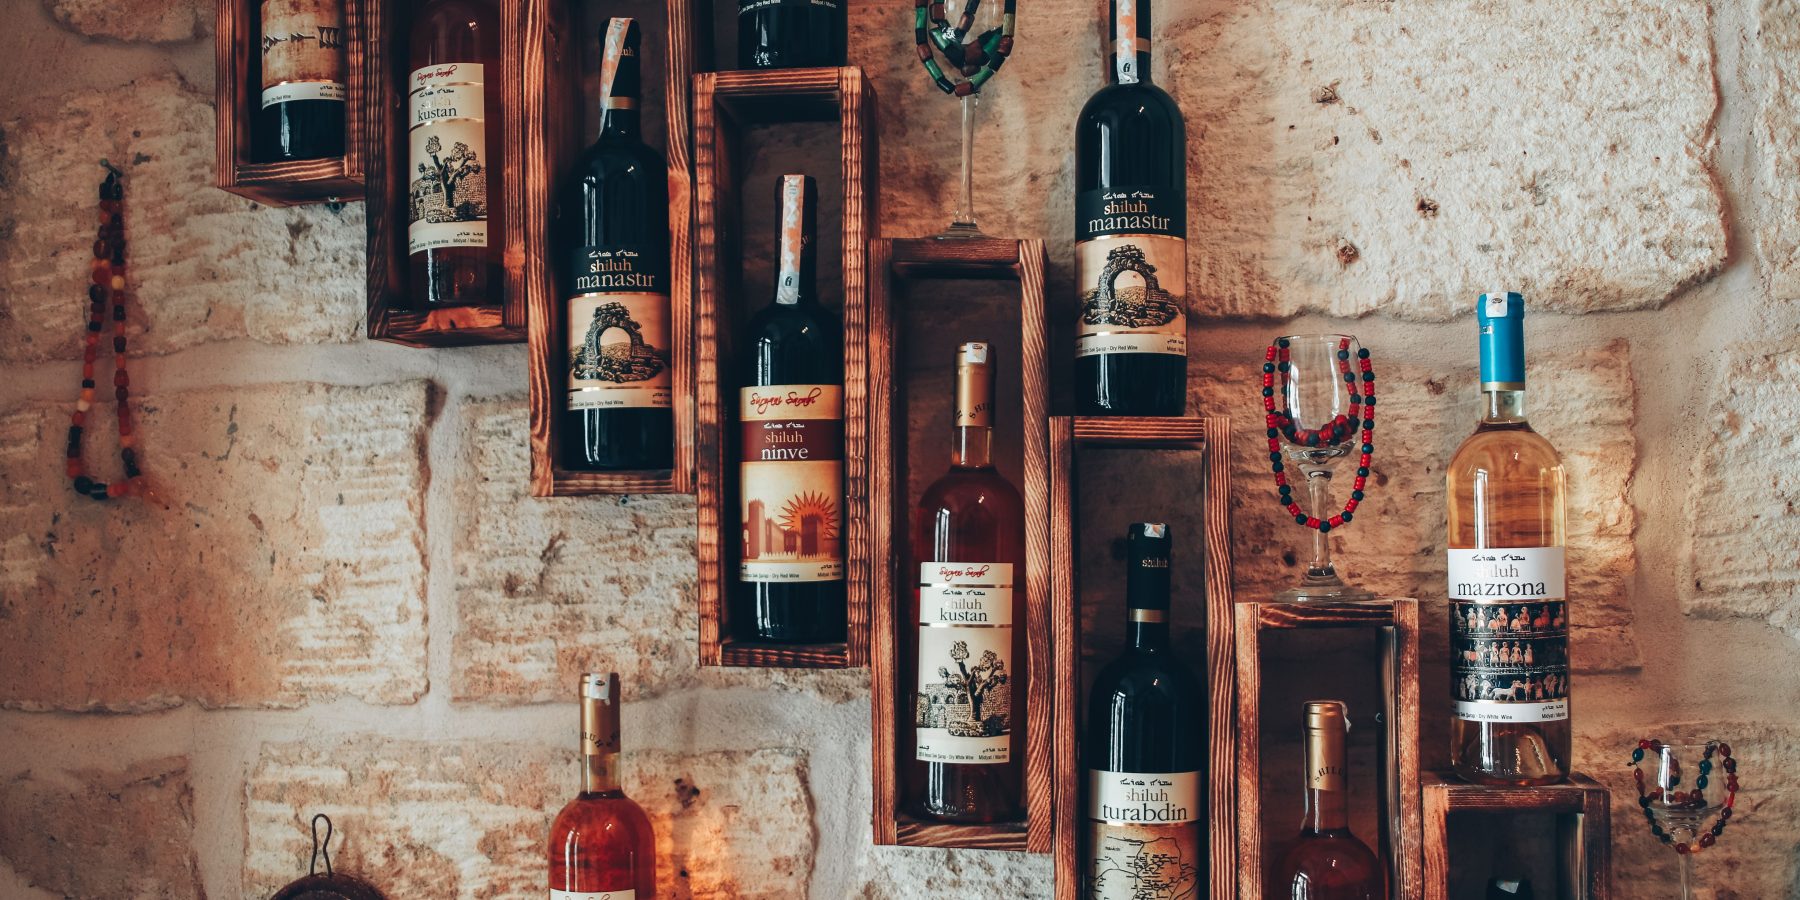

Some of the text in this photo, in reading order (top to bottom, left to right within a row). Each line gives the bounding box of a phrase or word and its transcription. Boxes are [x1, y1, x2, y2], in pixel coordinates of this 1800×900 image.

[418, 107, 457, 122] kustan
[1104, 200, 1148, 215] shiluh
[1088, 214, 1170, 232] manastır
[590, 259, 632, 273] shiluh
[576, 272, 655, 289] manastır
[765, 431, 803, 443] shiluh
[761, 445, 808, 460] ninve
[1458, 581, 1546, 596] mazrona
[948, 598, 982, 609] hiluh
[940, 608, 988, 622] kustan
[1126, 788, 1168, 801] shiluh
[1103, 803, 1188, 821] turabdin
